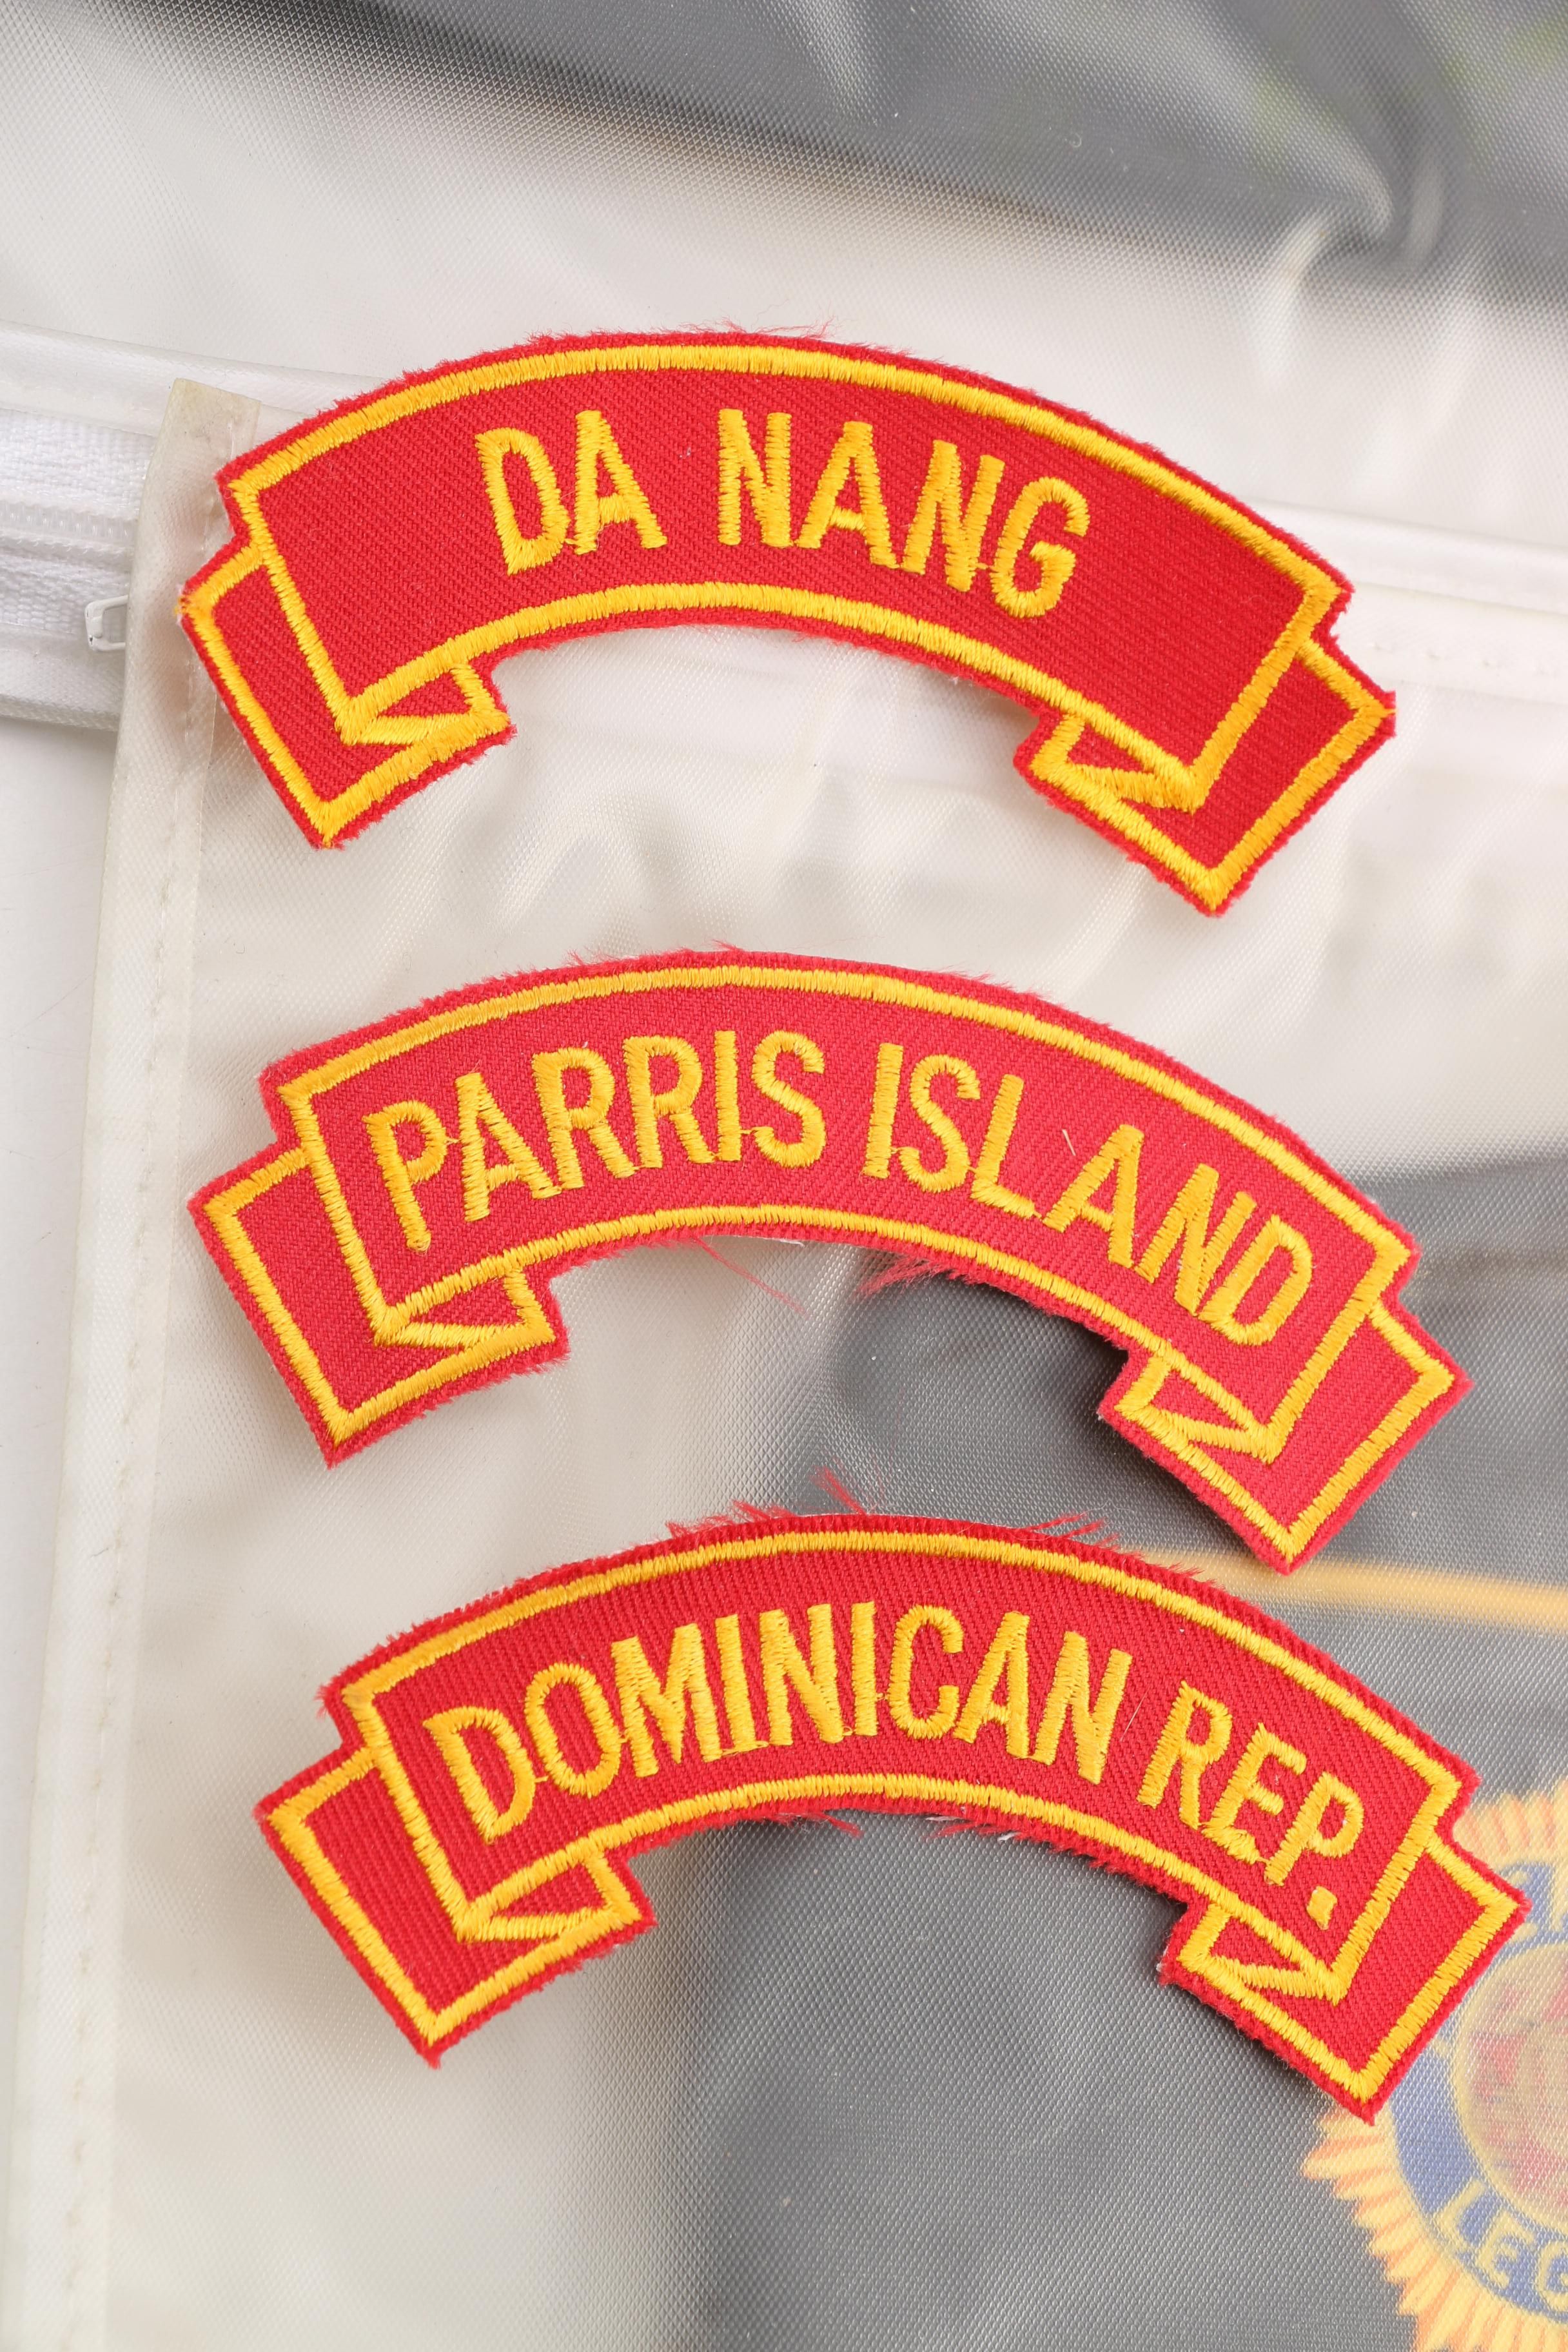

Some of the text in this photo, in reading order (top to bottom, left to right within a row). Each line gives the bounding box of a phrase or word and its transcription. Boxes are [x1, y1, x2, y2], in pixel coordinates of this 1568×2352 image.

[475, 408, 1090, 618] DA NANG
[363, 1030, 1313, 1346] PARRIS ISLAND
[422, 1601, 1364, 1929] DOMINICAN REP.
